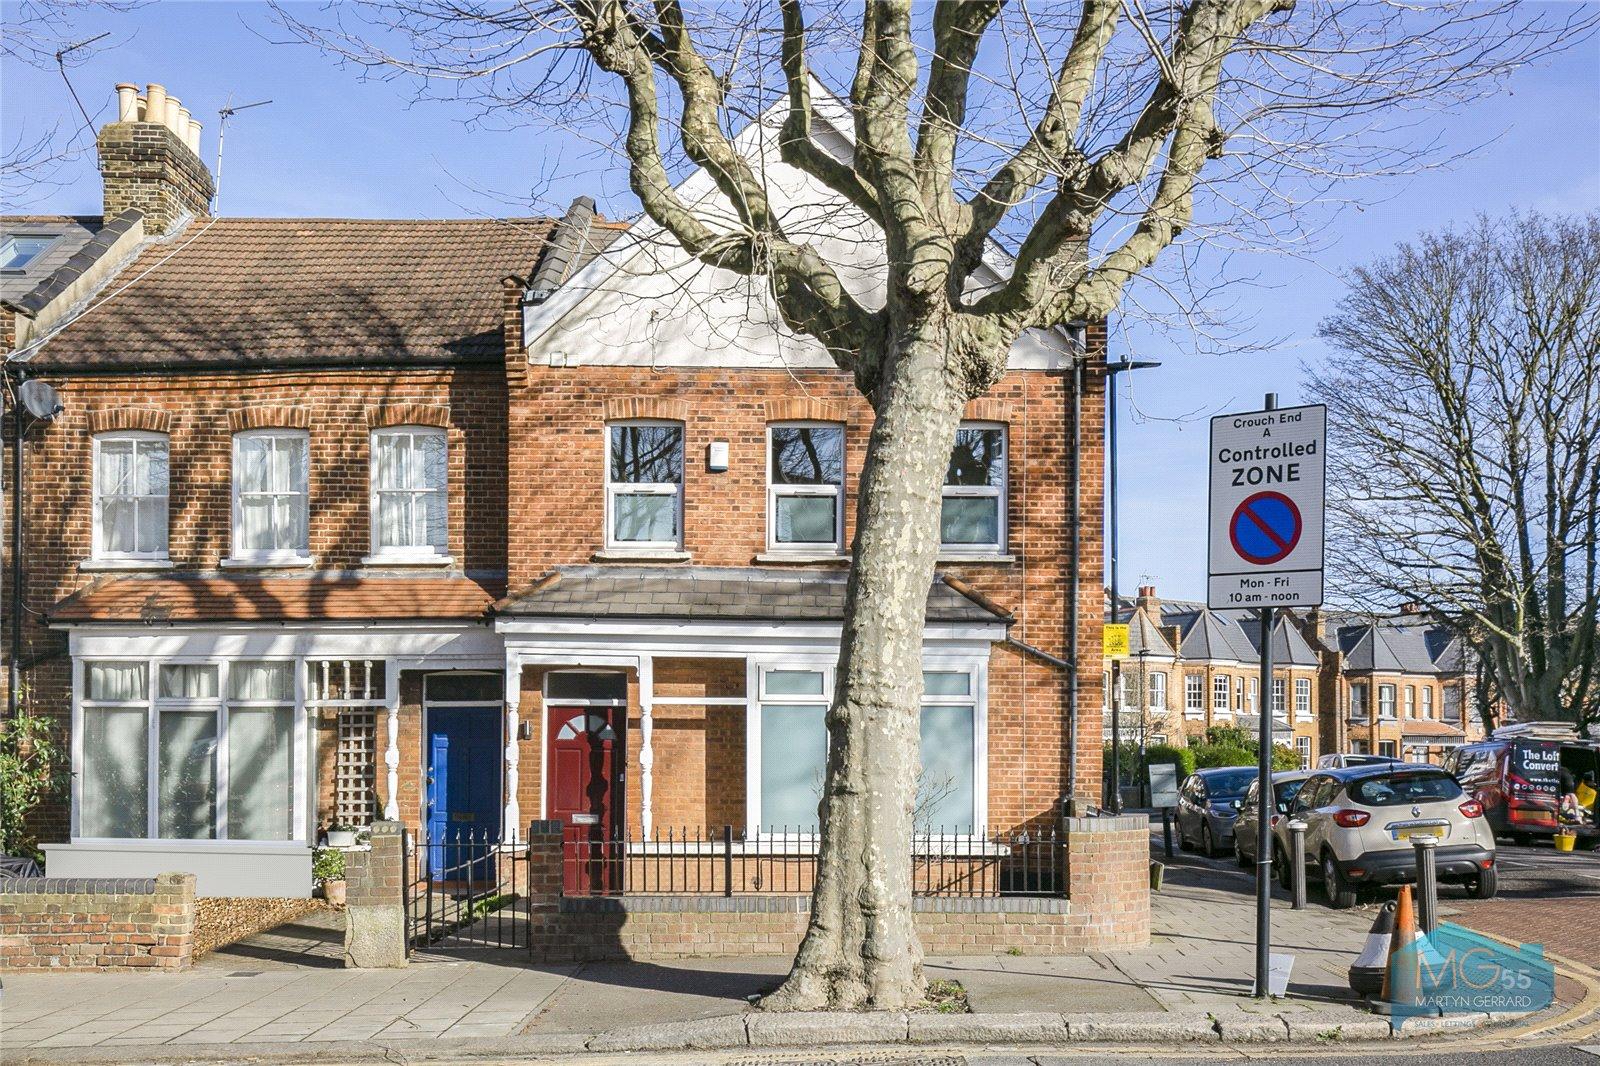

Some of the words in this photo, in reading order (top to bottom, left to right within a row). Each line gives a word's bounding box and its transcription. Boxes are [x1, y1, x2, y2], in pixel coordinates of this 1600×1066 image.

[1233, 415, 1275, 429] Crouch
[1279, 411, 1302, 424] End
[1262, 428, 1271, 438] A
[1218, 439, 1317, 464] Controlled
[1231, 462, 1301, 487] ZONE
[1240, 578, 1265, 588] Mon
[1274, 576, 1290, 587] Fri
[1229, 592, 1243, 603] 10
[1245, 593, 1262, 602] am
[1271, 592, 1300, 601] noon
[1522, 749, 1541, 760] The
[1542, 750, 1560, 761] Loft
[1522, 760, 1559, 771] Convert
